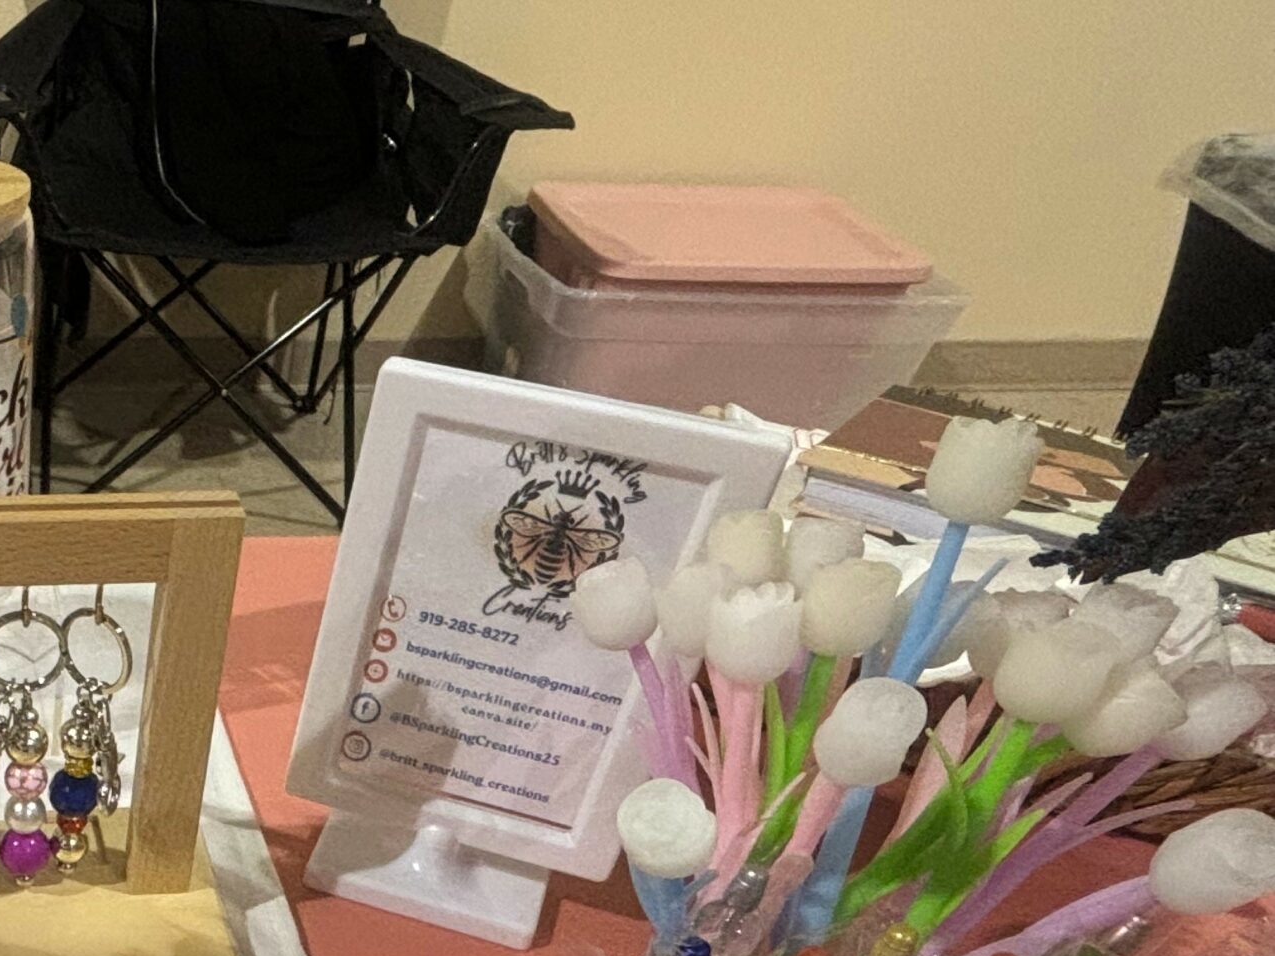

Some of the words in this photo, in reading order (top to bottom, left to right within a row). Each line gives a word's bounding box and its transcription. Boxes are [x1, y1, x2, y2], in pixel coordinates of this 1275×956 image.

[418, 610, 520, 647] 919-285-8272
[482, 583, 574, 631] Creations
[405, 640, 623, 706] bsparklingcreations@gmail.com
[389, 711, 561, 767] @BSparklingCreations25
